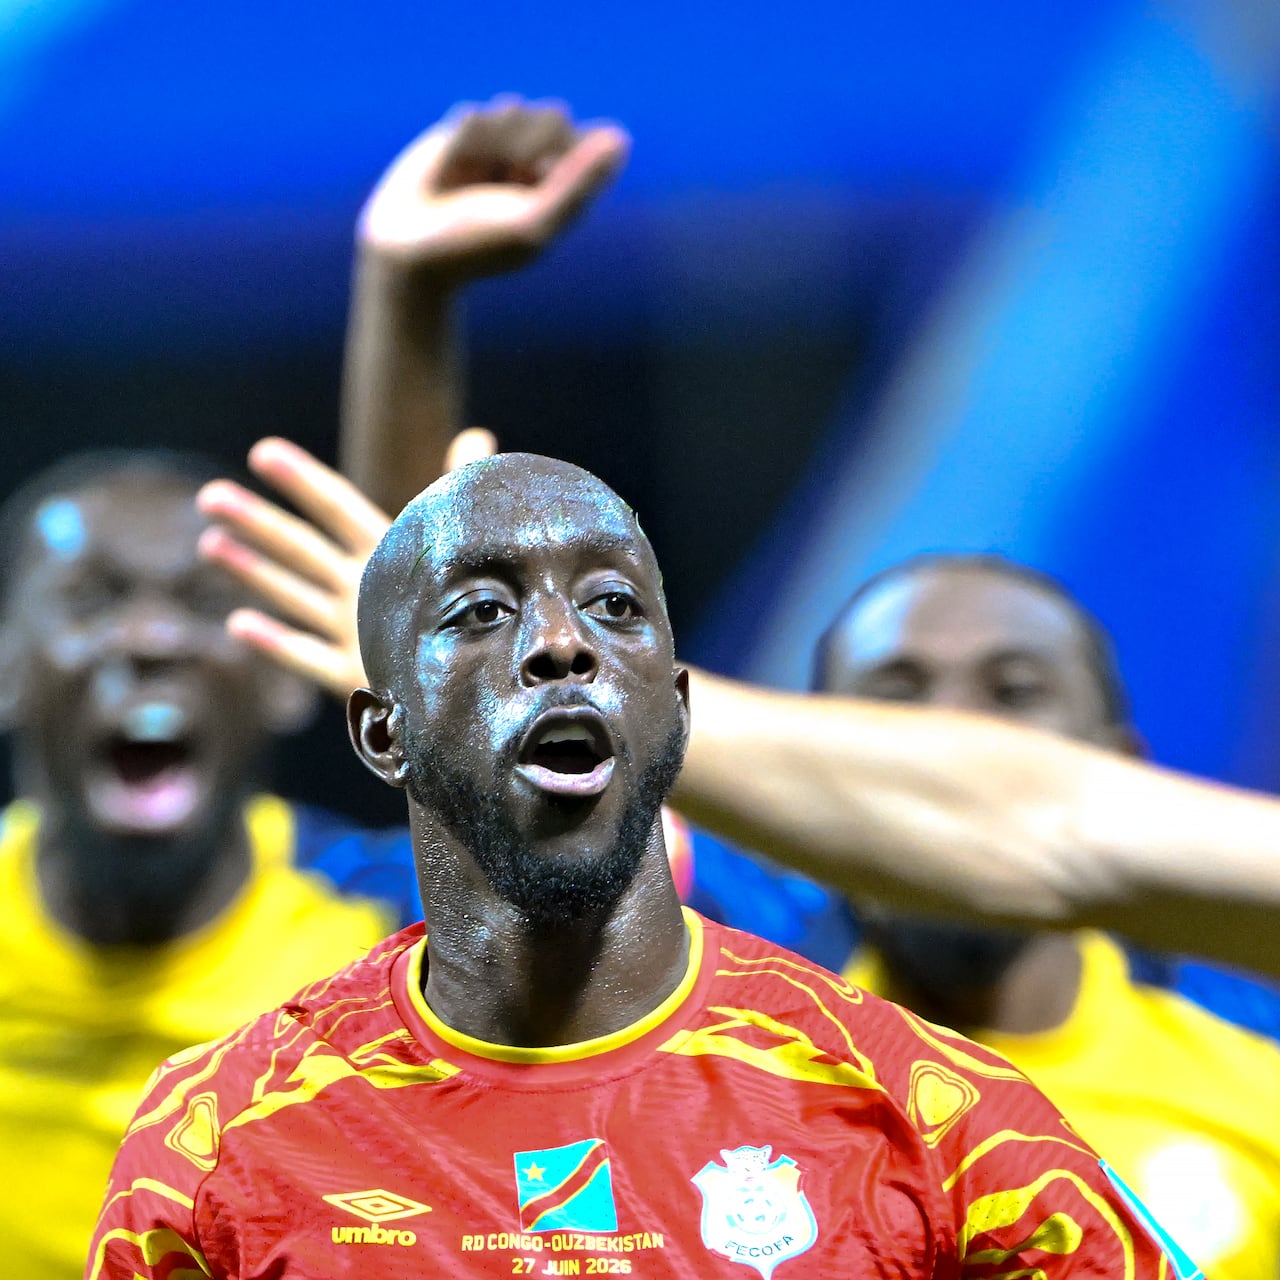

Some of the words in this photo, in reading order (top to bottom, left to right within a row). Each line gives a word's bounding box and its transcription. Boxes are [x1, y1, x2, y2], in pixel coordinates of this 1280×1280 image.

[332, 1223, 417, 1246] umbro
[461, 1234, 485, 1251] RD
[487, 1232, 665, 1252] CONGO-OUZBEKISTAN
[724, 1234, 795, 1258] FECOFA
[512, 1258, 536, 1274] 27
[541, 1258, 580, 1275] JUIN
[585, 1258, 632, 1275] 2026
